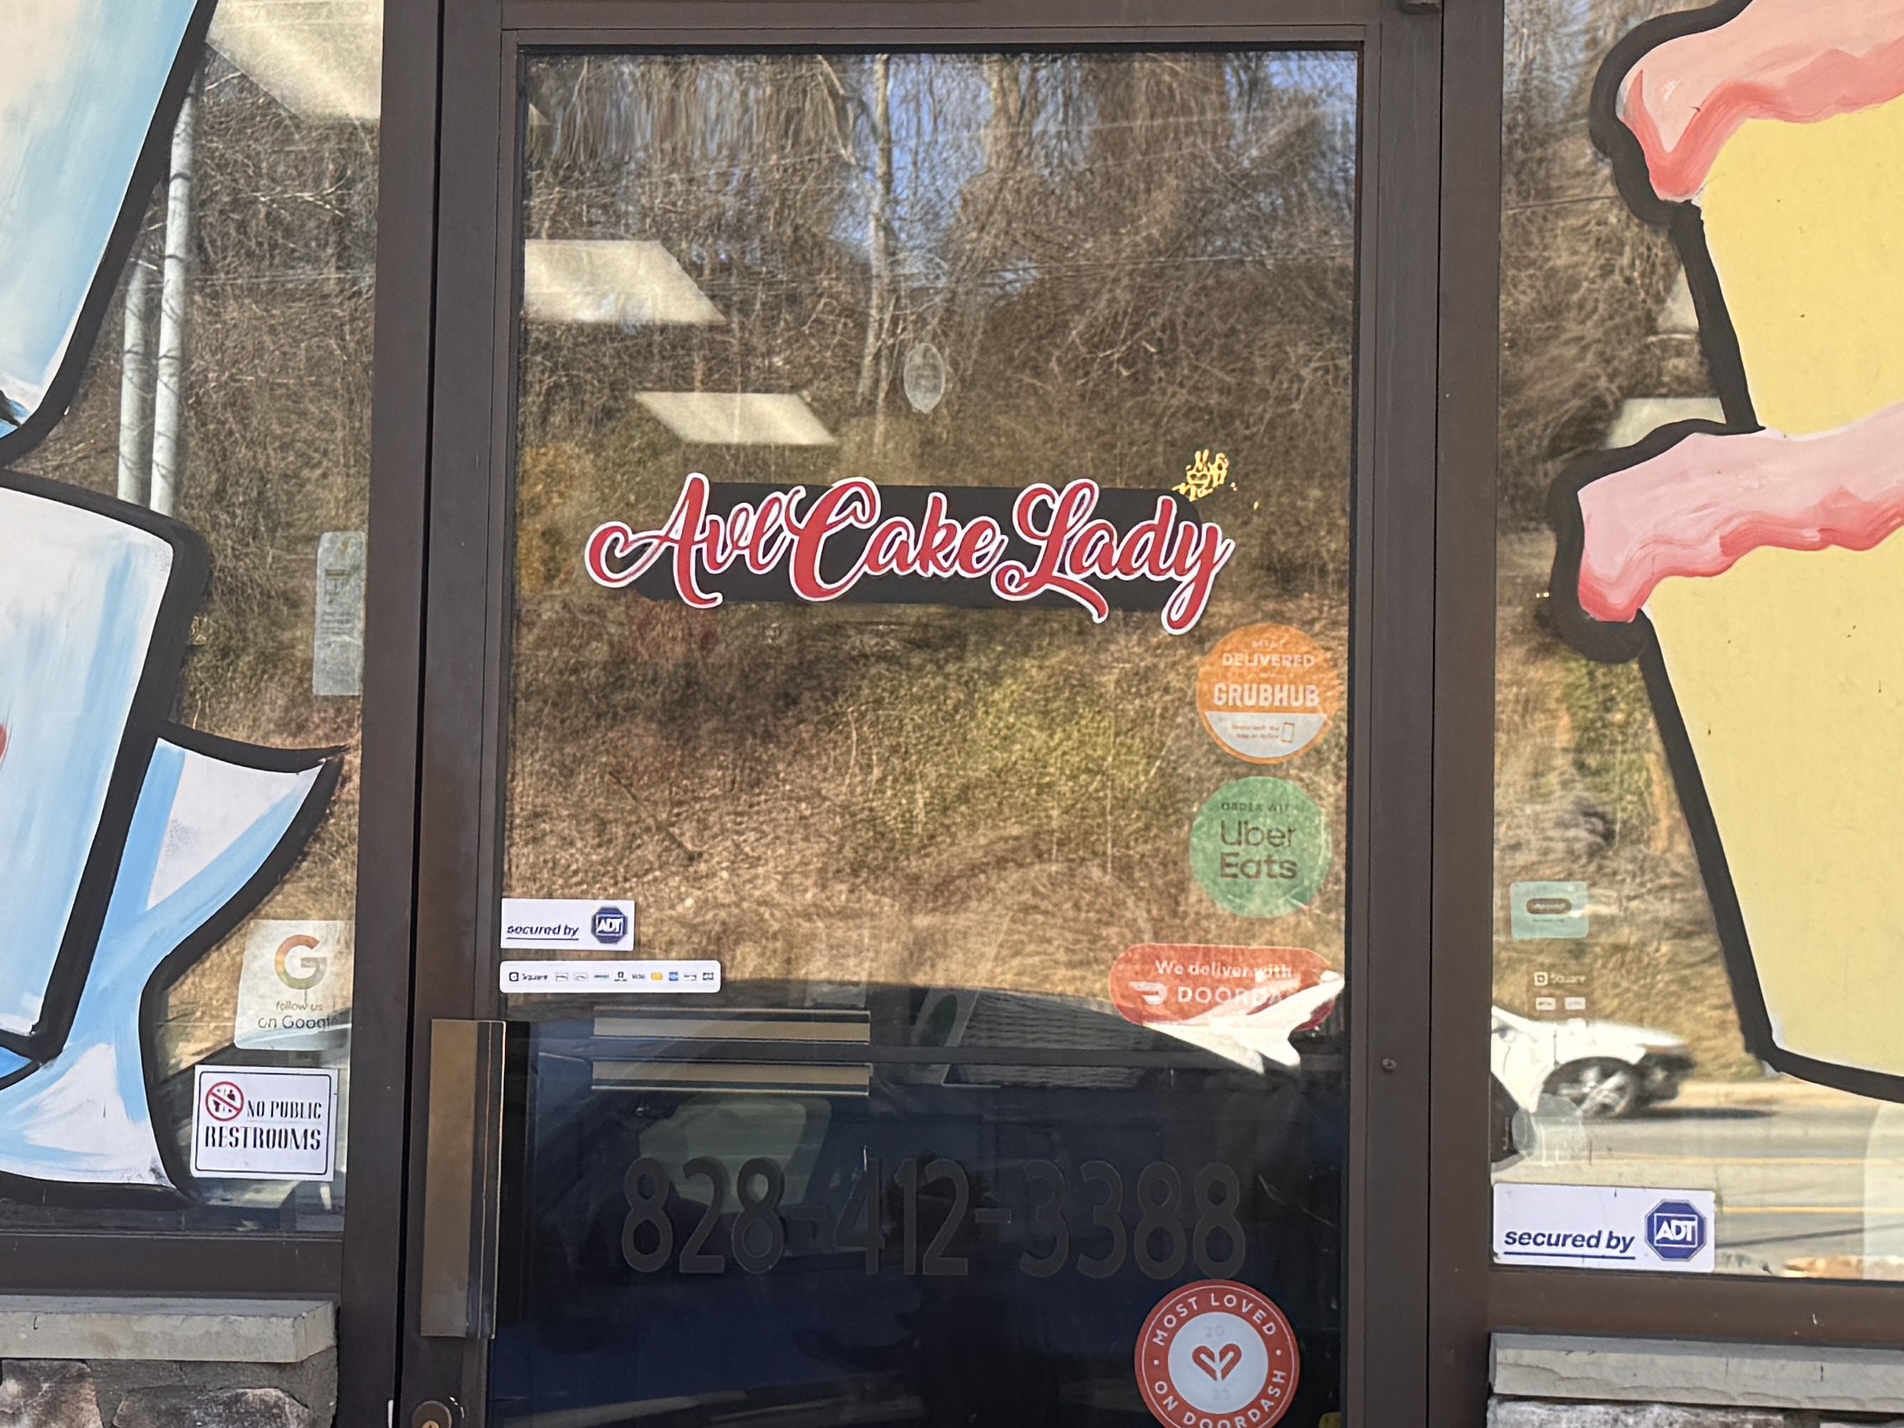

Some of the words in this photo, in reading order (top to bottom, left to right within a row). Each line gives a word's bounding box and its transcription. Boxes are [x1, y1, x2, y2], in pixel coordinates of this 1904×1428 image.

[585, 472, 794, 609] Avl
[785, 477, 1007, 601] Cake
[991, 478, 1234, 635] Lady
[1222, 653, 1316, 668] DELIVERED
[1213, 683, 1320, 708] GRUBHUB
[1220, 819, 1297, 847] Uber
[1219, 852, 1298, 880] Eats
[507, 923, 561, 936] secured
[563, 925, 579, 938] by
[596, 917, 624, 934] ADT
[1155, 959, 1184, 975] We
[1188, 961, 1248, 979] deliver
[1252, 963, 1293, 980] with
[276, 1000, 308, 1011] follow
[310, 1003, 323, 1011] us
[258, 1017, 277, 1029] on
[247, 1099, 265, 1119] NO
[270, 1101, 322, 1120] PUBLIC
[205, 1126, 321, 1151] RESTROOMS
[621, 1156, 1247, 1281] 828-412-3388
[1504, 1228, 1602, 1250] secured
[1606, 1230, 1635, 1255] by
[1655, 1218, 1698, 1243] ADT
[1152, 1296, 1199, 1346] MOST
[1210, 1292, 1277, 1336] LOVED
[1204, 1325, 1226, 1338] 20
[1154, 1380, 1179, 1411] ON
